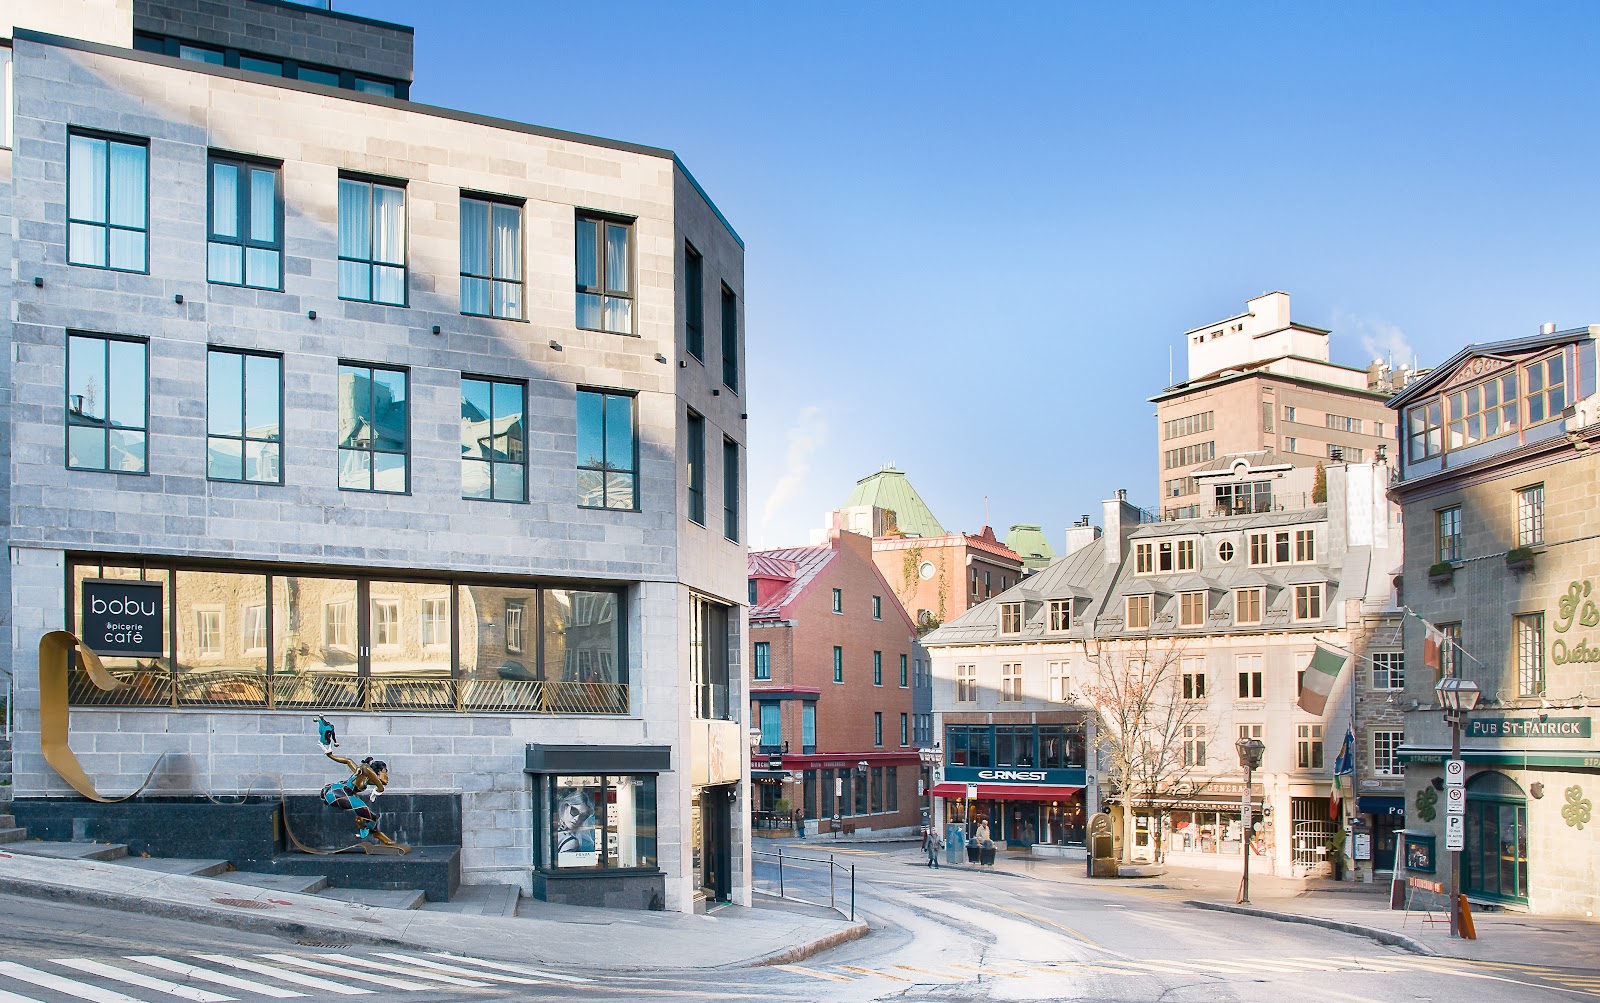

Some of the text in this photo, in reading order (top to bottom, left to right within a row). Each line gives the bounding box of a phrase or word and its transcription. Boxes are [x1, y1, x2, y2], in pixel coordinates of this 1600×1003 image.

[92, 594, 155, 616] bobu
[106, 621, 143, 631] épicerie
[1552, 637, 1600, 666] Québe
[978, 770, 1048, 781] ERNEST
[1450, 817, 1459, 827] P
